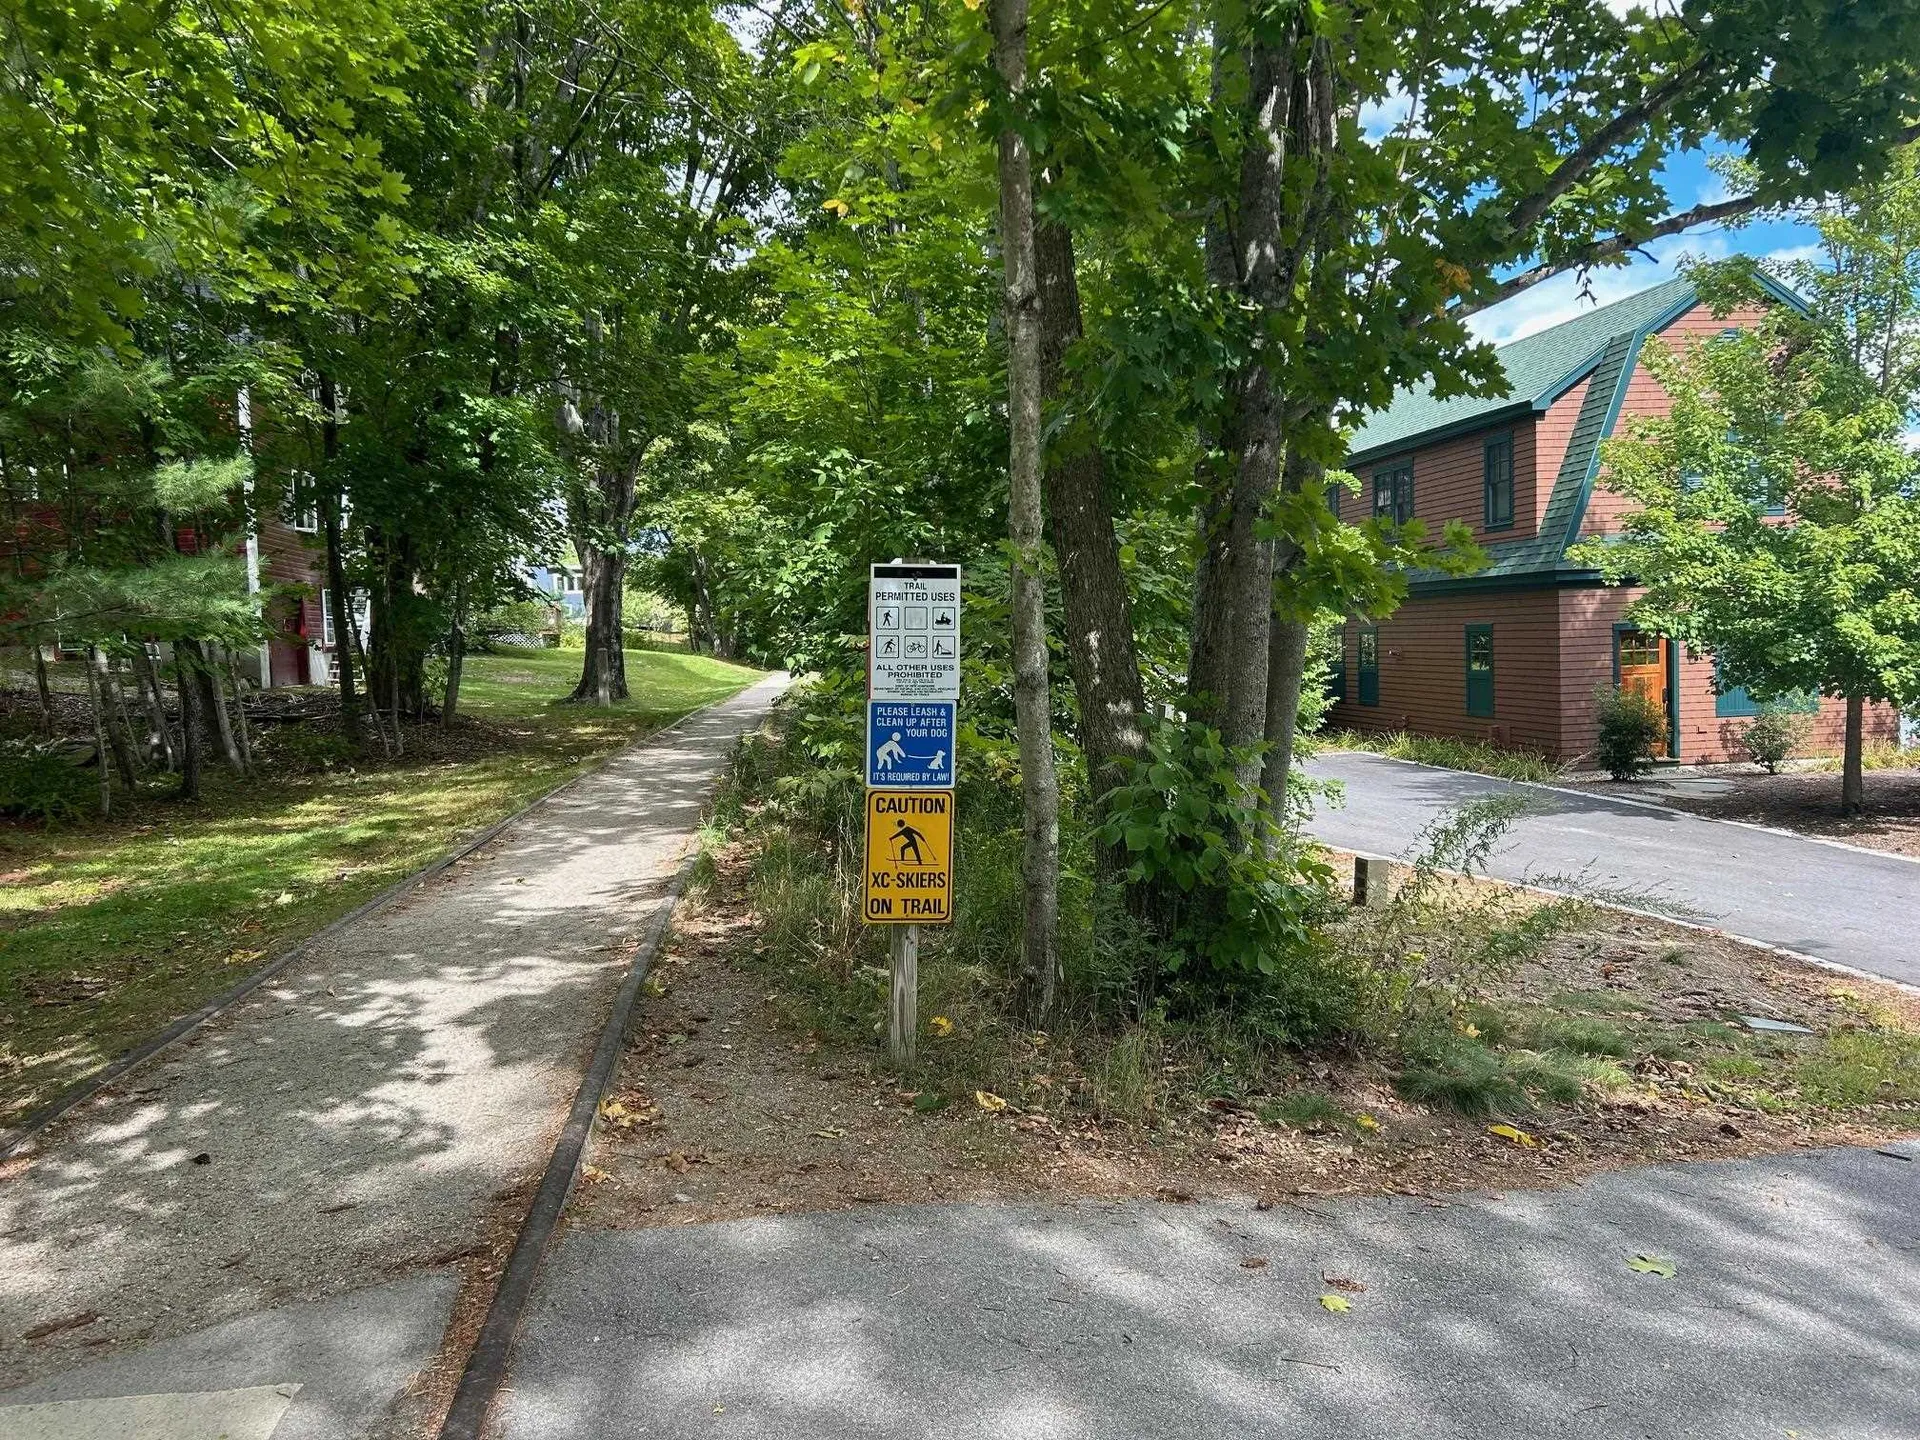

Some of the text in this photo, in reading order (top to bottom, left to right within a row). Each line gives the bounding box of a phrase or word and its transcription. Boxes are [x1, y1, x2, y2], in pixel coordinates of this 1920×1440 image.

[904, 582, 927, 590] TRAIL
[876, 592, 955, 601] PERMITTED USES
[877, 707, 908, 716] PLEASE
[911, 707, 937, 716] LEASH
[876, 718, 946, 727] CLEAN UP AFTER
[906, 729, 948, 737] YOUR DOG
[873, 772, 949, 781] IT'S REQUIRED BY LAW!
[876, 797, 945, 814] CAUTION
[871, 872, 946, 888] XC-SKIERS
[870, 898, 945, 914] ON TRAIL
